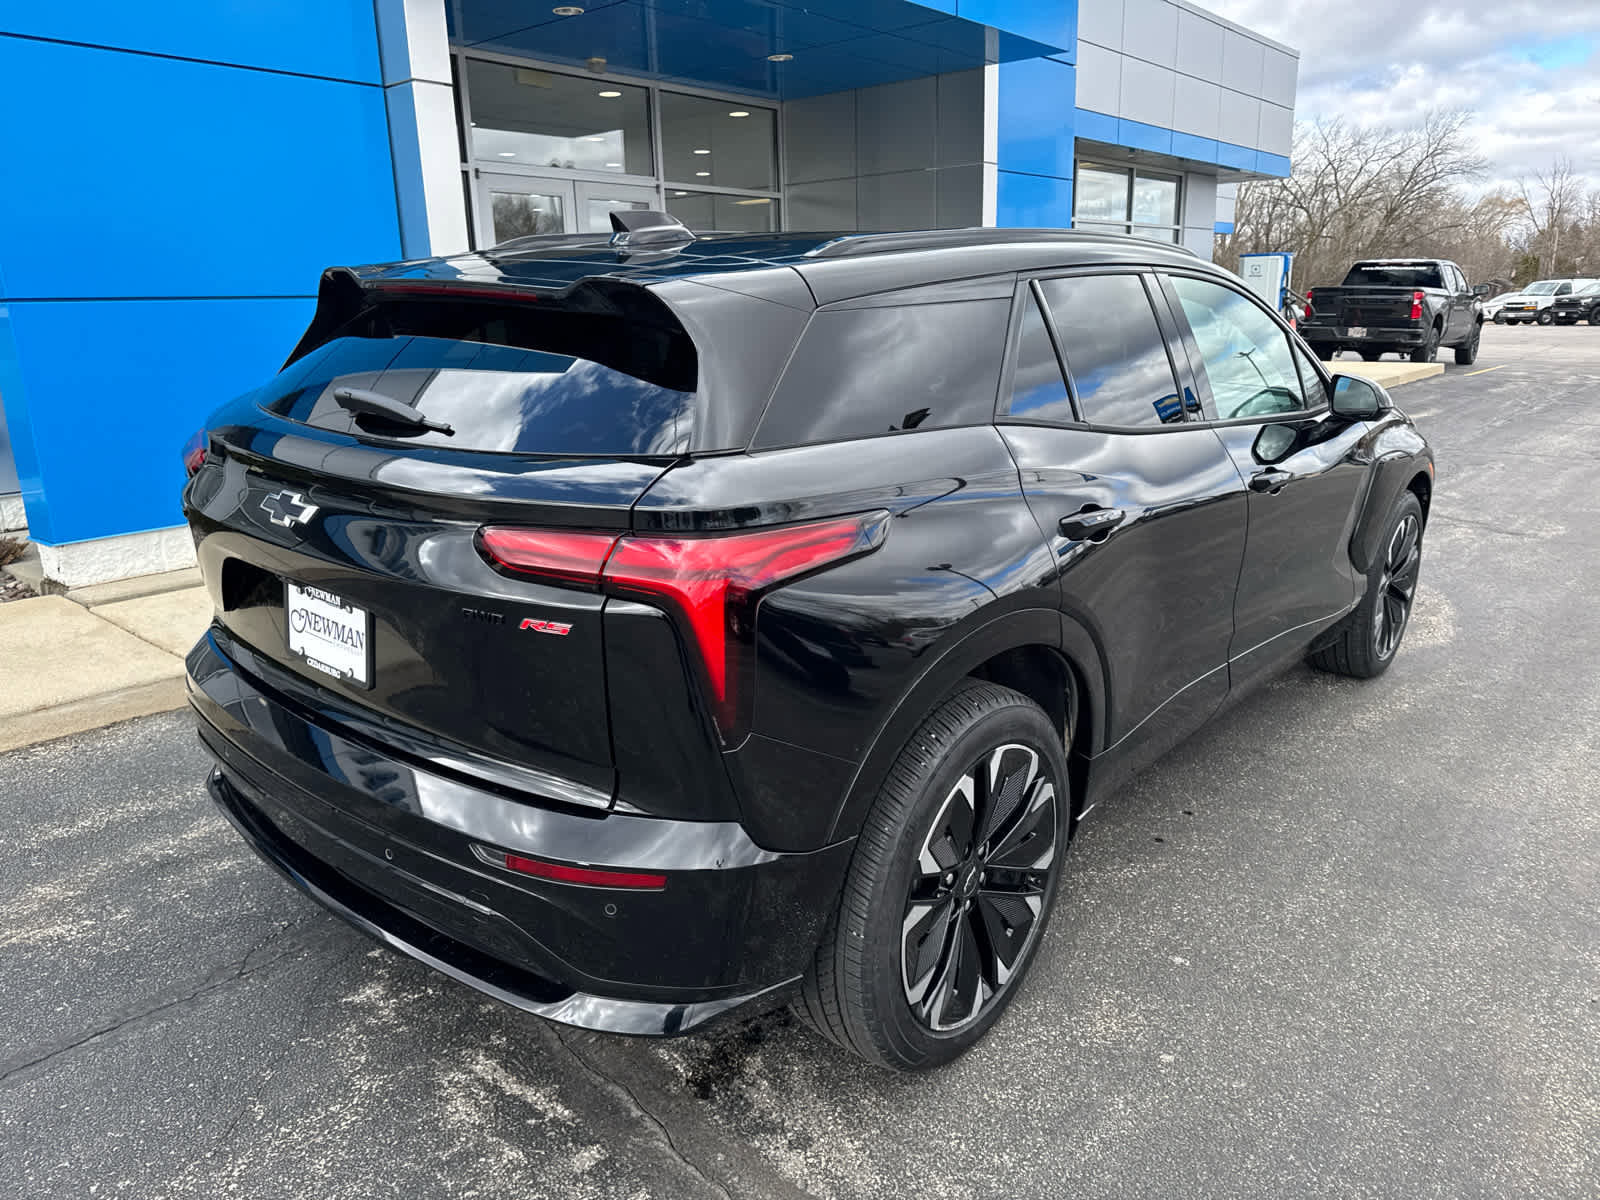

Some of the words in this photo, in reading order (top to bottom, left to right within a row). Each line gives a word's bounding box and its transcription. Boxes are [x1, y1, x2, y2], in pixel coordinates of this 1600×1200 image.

[304, 585, 341, 606] NEWMAN
[290, 608, 365, 650] NEWMAN
[519, 617, 574, 635] RS
